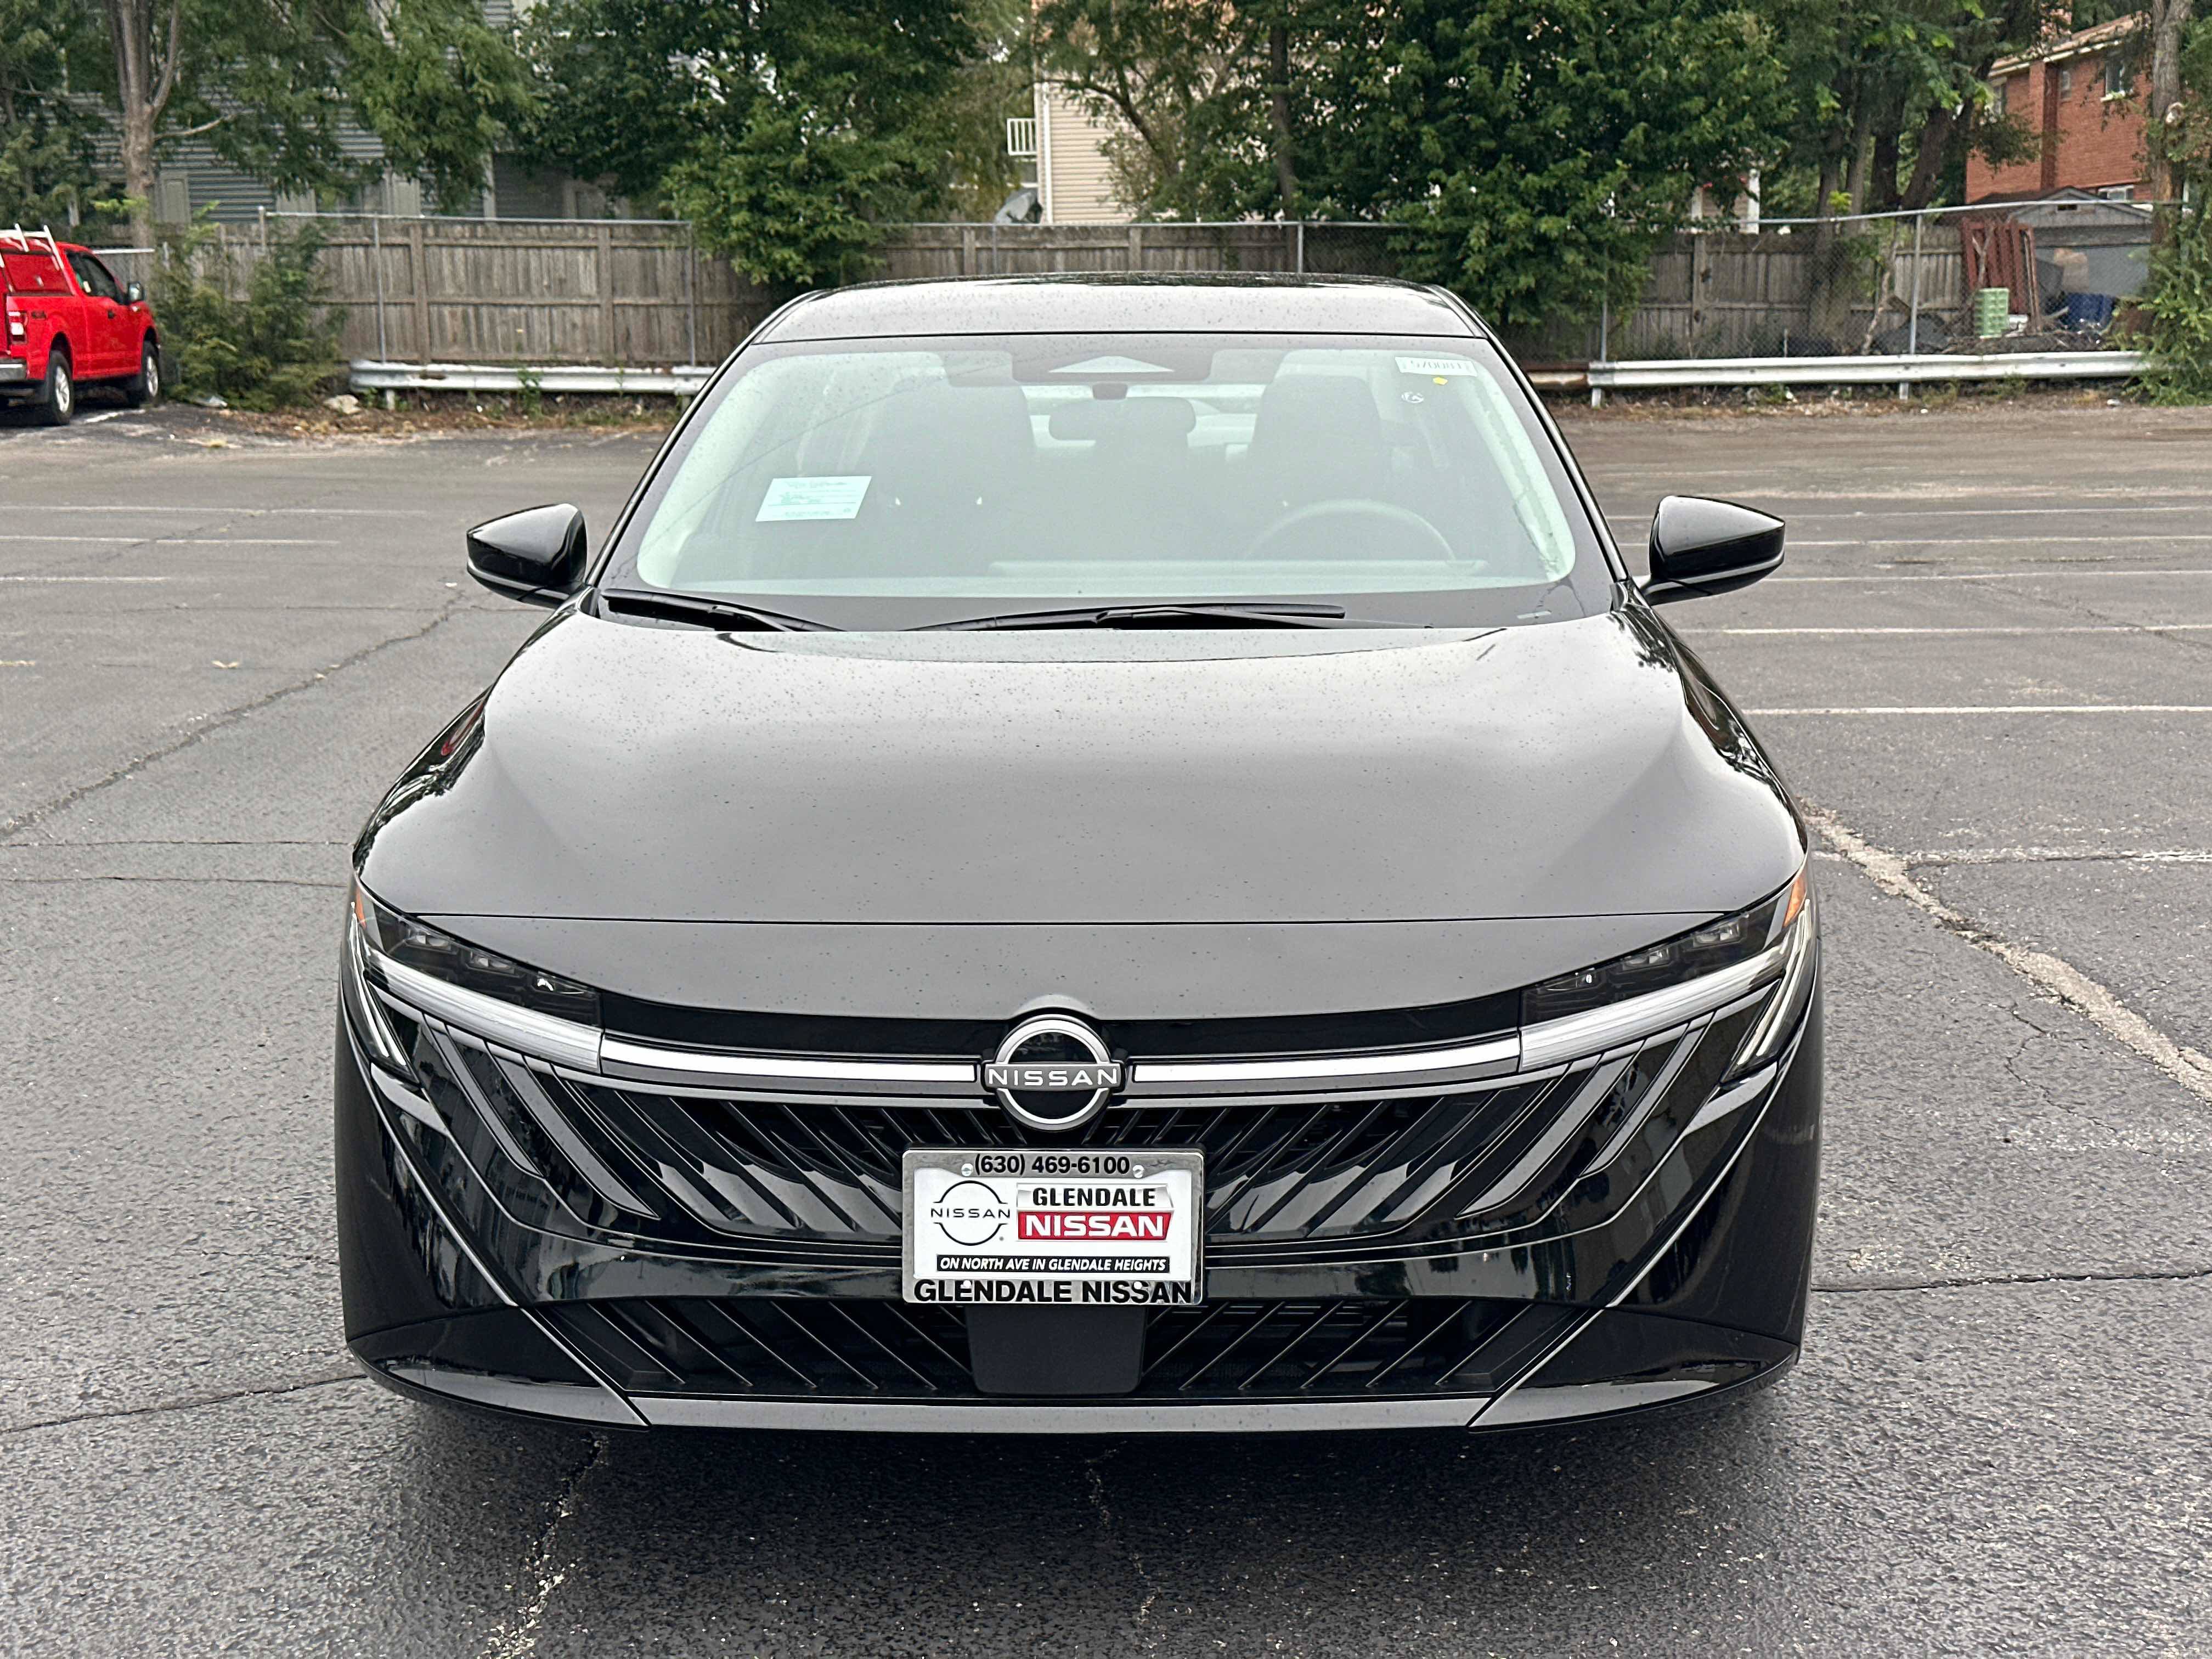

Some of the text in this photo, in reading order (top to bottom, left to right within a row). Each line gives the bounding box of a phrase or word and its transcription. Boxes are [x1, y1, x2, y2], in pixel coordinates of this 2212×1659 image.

[989, 1069, 1118, 1086] NISSAN
[975, 1153, 1130, 1176] (630) 469-6100
[1032, 1187, 1156, 1207] GLENDALE
[930, 1207, 1011, 1218] NISSAN
[1025, 1215, 1164, 1237] NISSAN
[940, 1257, 1167, 1272] ON NORTH AVE IN GLENDALE HEIGHTS
[913, 1279, 1192, 1304] GLENDALE NISSAN
